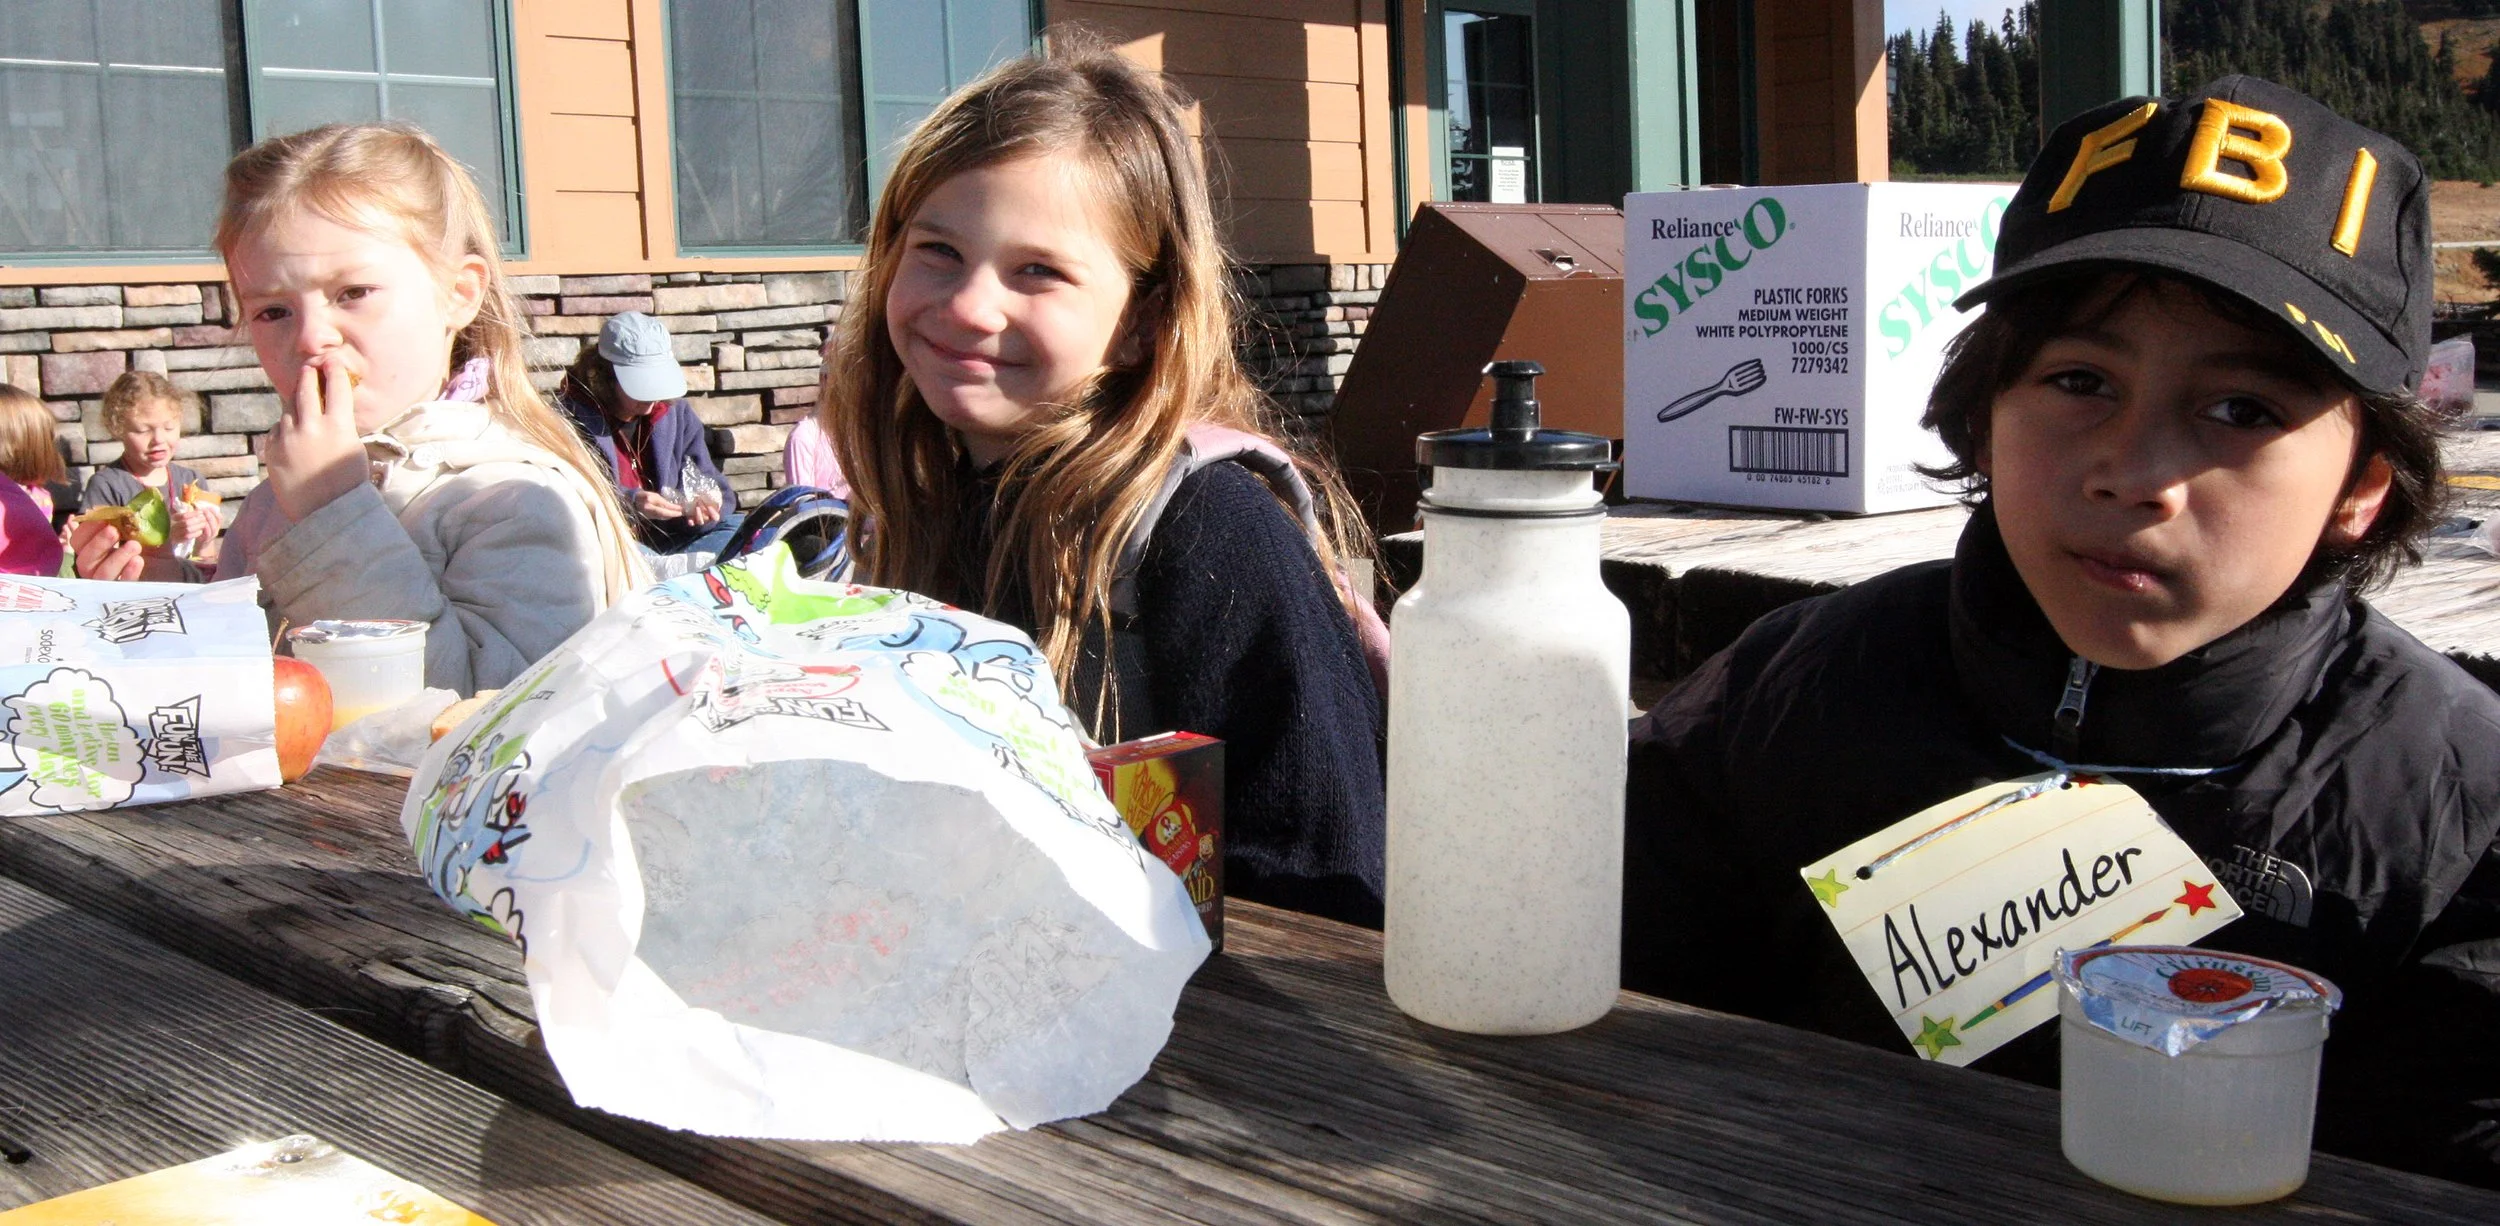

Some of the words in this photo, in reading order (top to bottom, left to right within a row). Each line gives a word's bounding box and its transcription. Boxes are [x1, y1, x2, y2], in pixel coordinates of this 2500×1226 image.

[2048, 97, 2377, 257] FBI
[1651, 217, 1735, 241] Reliance
[1899, 211, 1973, 238] Reliance
[1634, 197, 1787, 339] SYSCO
[1754, 287, 1802, 305] PLASTIC
[1806, 286, 1849, 305] FORKS
[1738, 308, 1792, 322] MEDIUM
[1795, 307, 1849, 321] WEIGHT
[1695, 325, 1735, 338] WHITE
[1738, 324, 1849, 338] POLYPROPYLENE
[1791, 341, 1849, 355] 1000/CS
[1791, 356, 1849, 374] 7279342
[1774, 407, 1849, 426] FW-FW-SYS
[2232, 844, 2282, 875] THE
[2207, 857, 2276, 894] ORTH
[1883, 845, 2142, 1009] Alexander
[2120, 1015, 2154, 1036] LIFT
